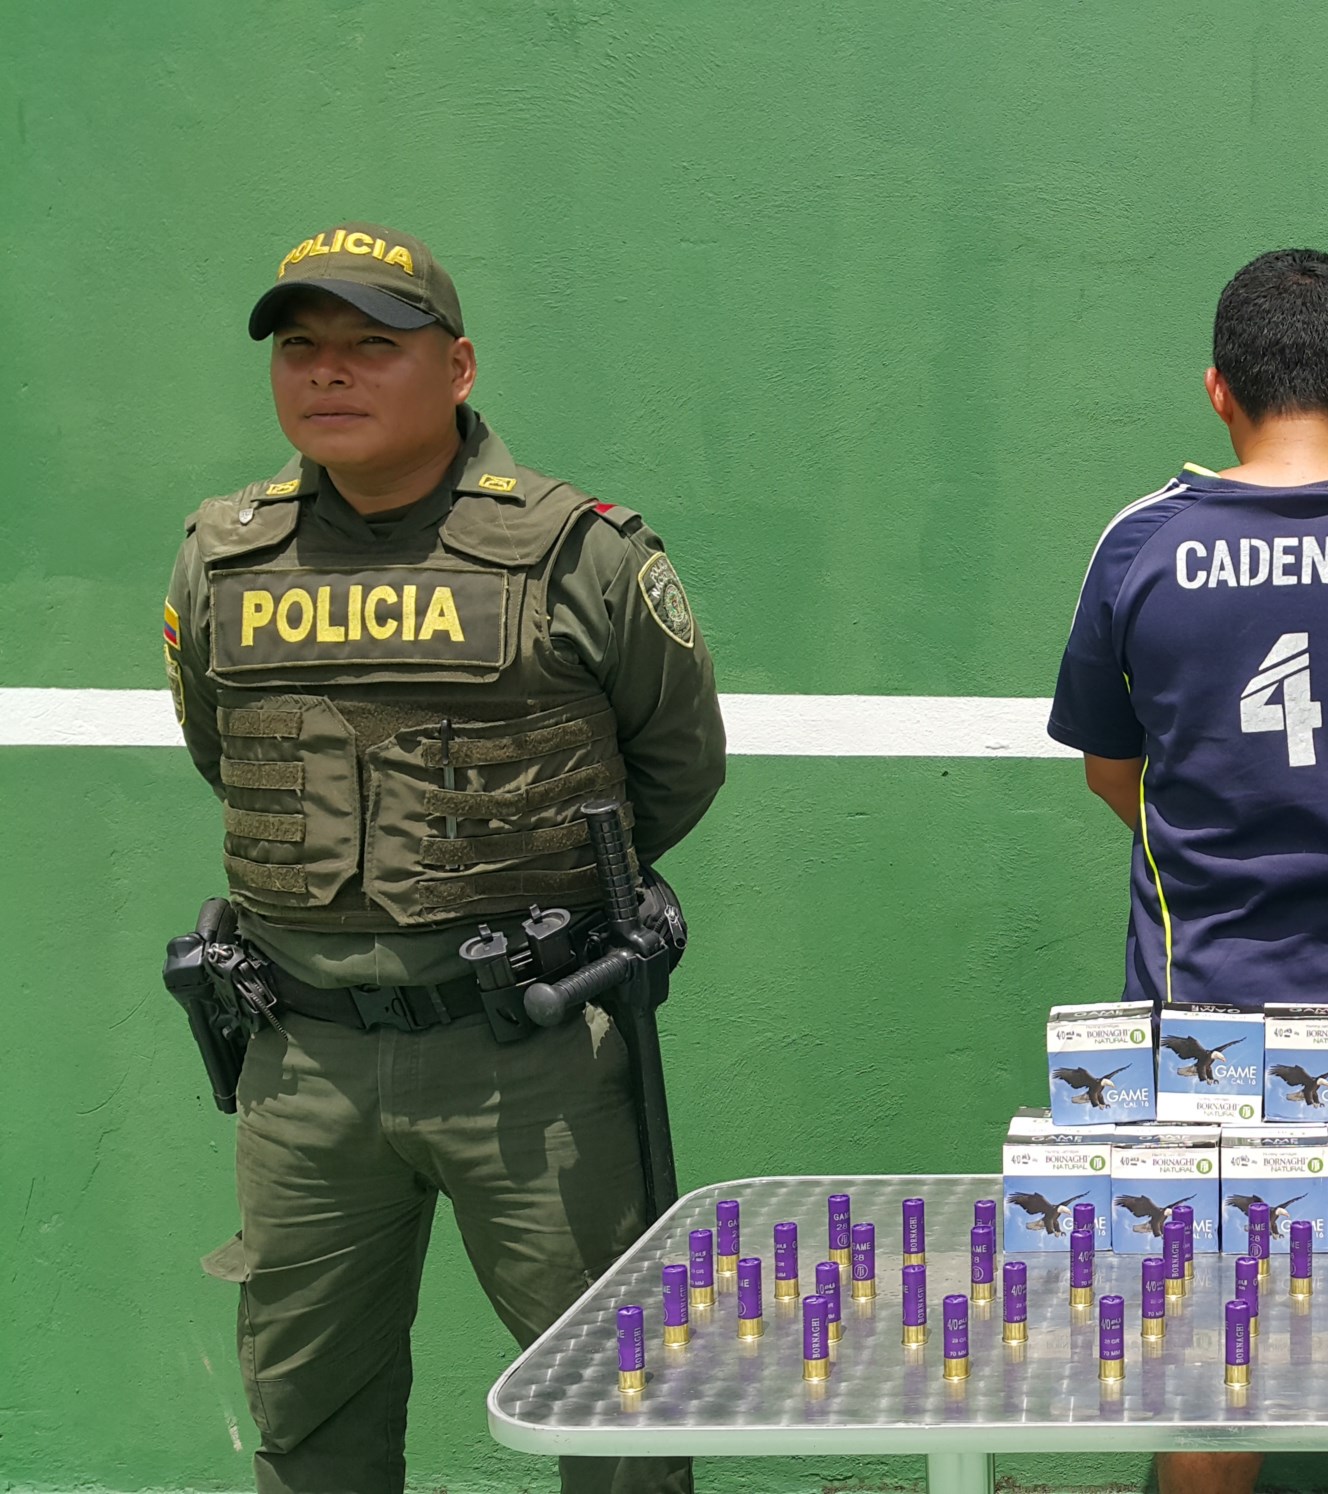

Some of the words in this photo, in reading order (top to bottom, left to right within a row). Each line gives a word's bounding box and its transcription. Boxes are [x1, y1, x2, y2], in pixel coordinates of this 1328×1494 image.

[279, 229, 414, 278] POLICIA
[241, 585, 465, 646] POLICIA
[1240, 632, 1322, 767] 4
[1087, 1029, 1127, 1038] BORNAGHI
[1215, 1065, 1257, 1078] GAME
[1106, 1088, 1148, 1102] GAME
[1197, 1102, 1237, 1110] BORNAGHI
[1045, 1155, 1087, 1164] BORNAGHI
[1153, 1158, 1194, 1166] BORNAGHI
[1264, 1158, 1305, 1166] BORNAGHI
[910, 1217, 918, 1252] BORNAGHI
[853, 1253, 865, 1261] 28
[811, 1318, 820, 1358] BORNAGHI
[1235, 1323, 1244, 1364] BORNAGHI
